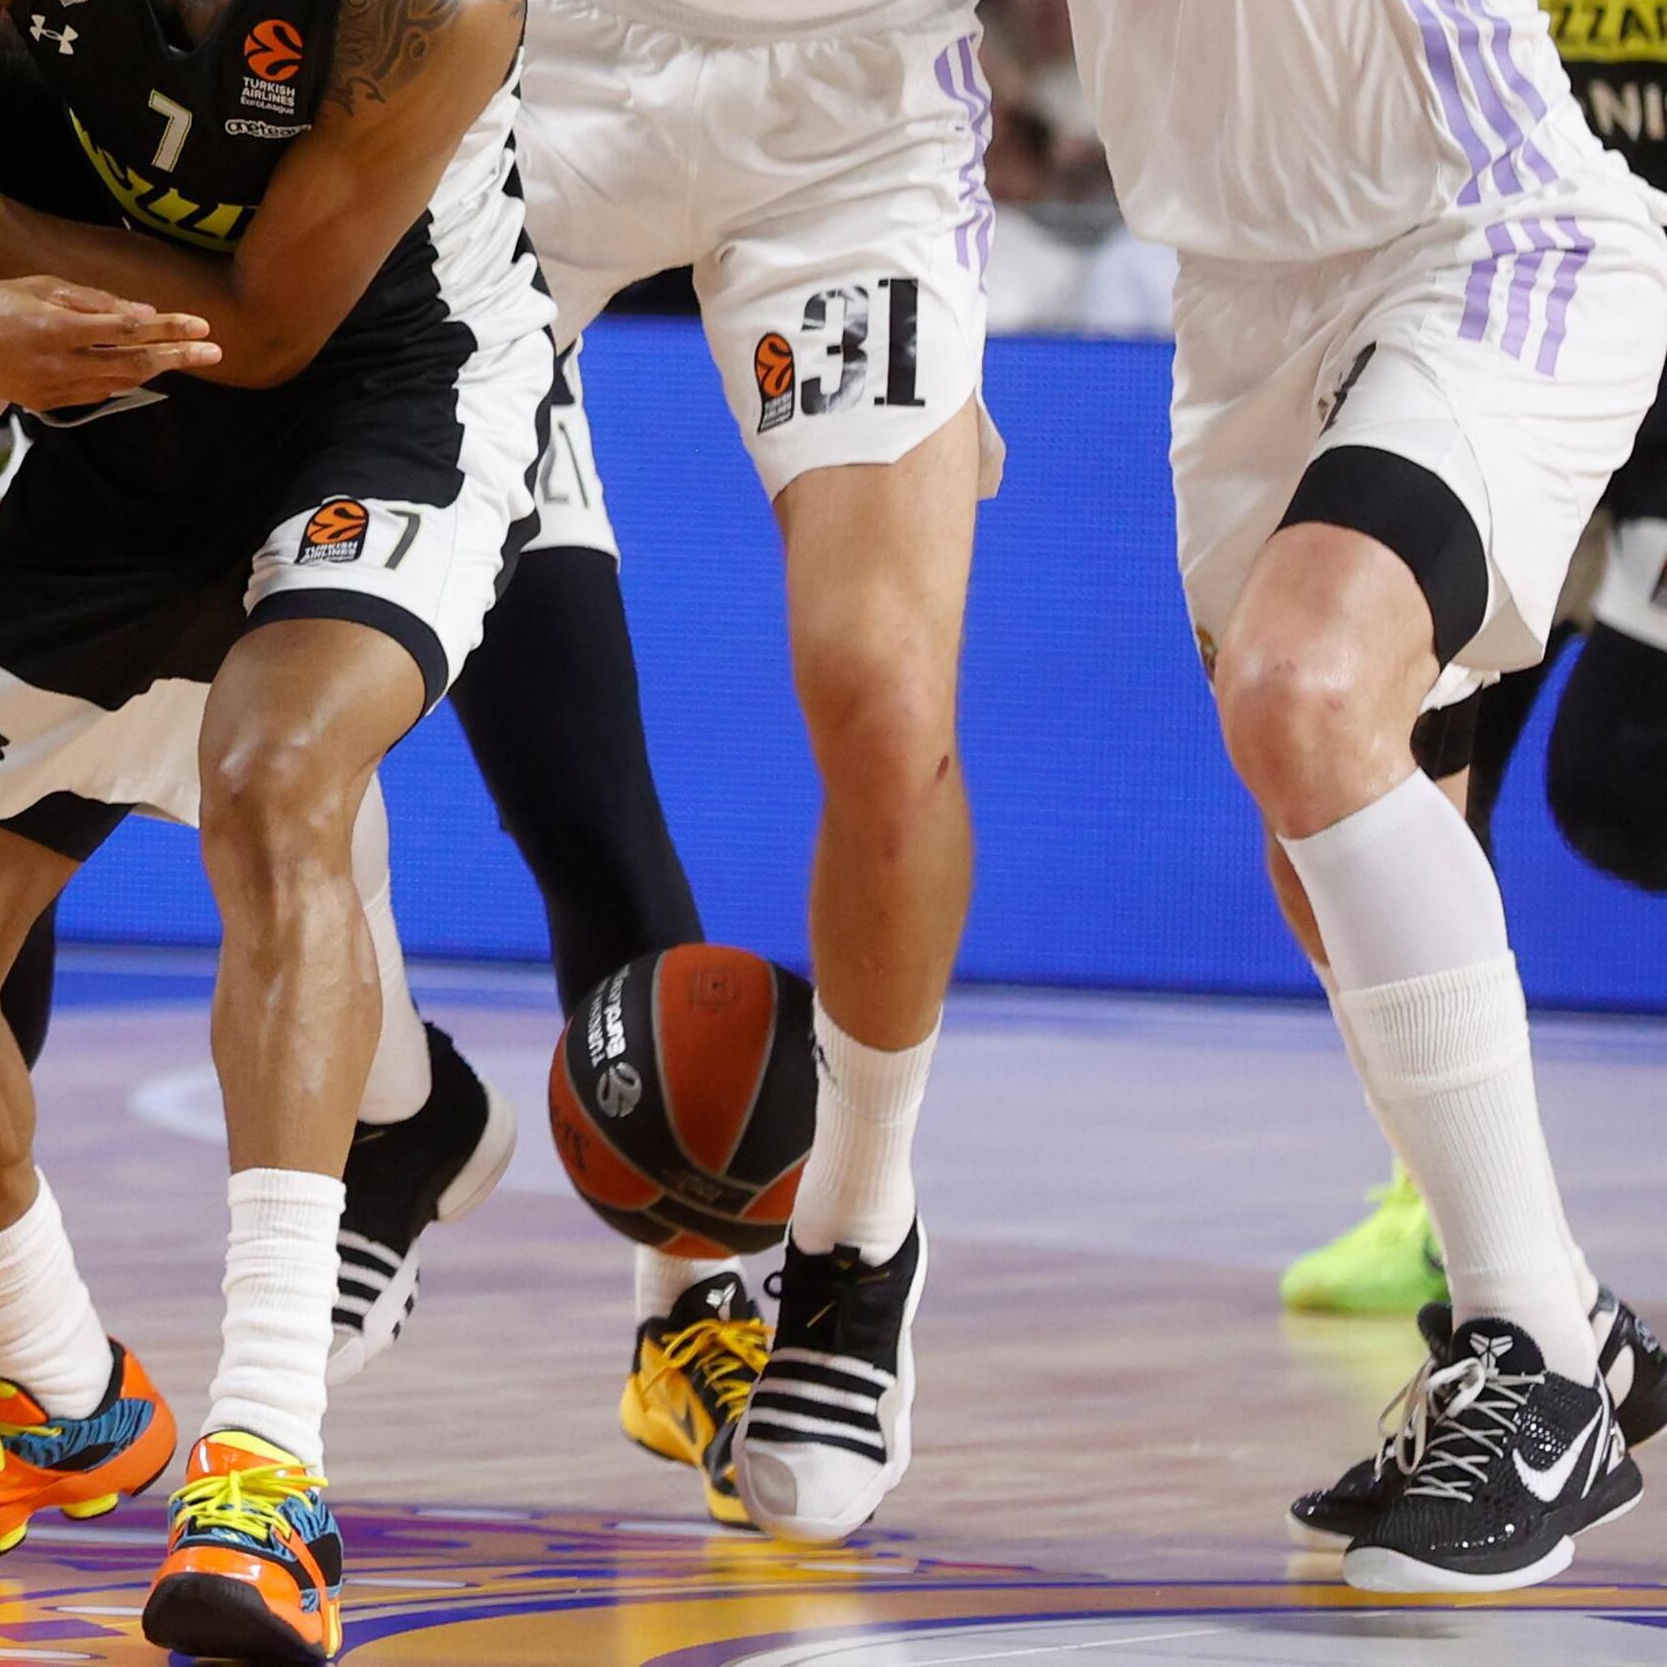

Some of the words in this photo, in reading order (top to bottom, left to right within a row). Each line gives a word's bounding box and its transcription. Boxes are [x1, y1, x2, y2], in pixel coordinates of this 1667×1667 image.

[241, 87, 295, 107] AIRLINES
[243, 76, 295, 97] TURKISH
[148, 88, 193, 173] 7
[800, 278, 925, 416] 31
[384, 508, 422, 571] 7
